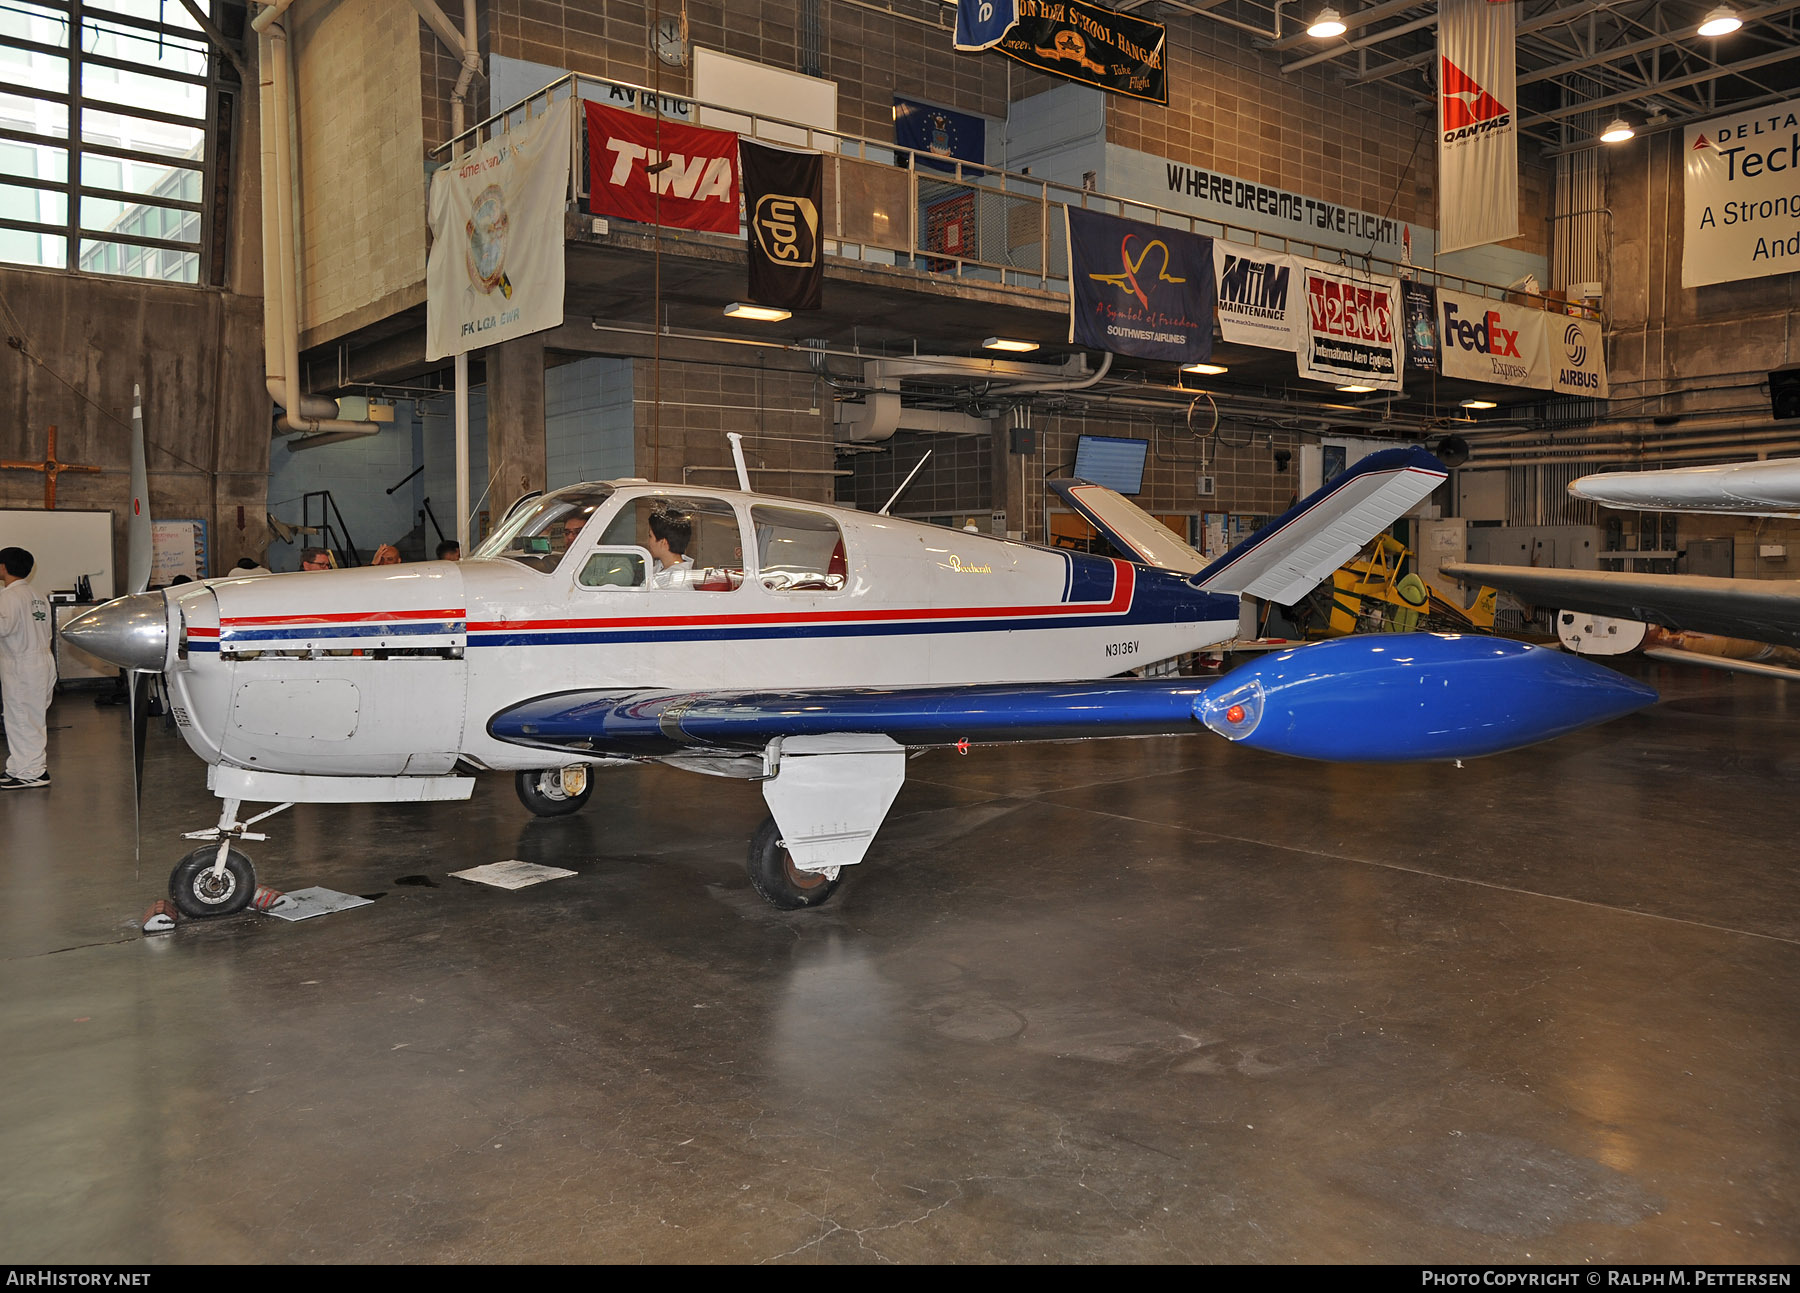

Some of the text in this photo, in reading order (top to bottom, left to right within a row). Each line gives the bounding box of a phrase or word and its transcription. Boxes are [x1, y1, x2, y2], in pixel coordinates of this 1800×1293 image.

[1117, 32, 1163, 70] HANGAR
[1111, 64, 1132, 75] Take
[1129, 76, 1150, 91] Flight
[1443, 114, 1510, 143] QANTAS
[1719, 113, 1798, 143] DELTA
[606, 136, 732, 203] TWA
[761, 201, 800, 260] ups
[1348, 211, 1398, 245] FLIGHT!
[1700, 206, 1715, 230] A
[1752, 231, 1800, 261] And
[477, 315, 497, 332] LGA
[500, 307, 520, 325] EWR
[1096, 301, 1198, 328] A Symbol of Freedom
[1218, 301, 1285, 321] MAINTENANCE
[1309, 293, 1390, 338] V2500
[1107, 325, 1186, 345] SOUTHWEST AIRLINES
[1223, 317, 1290, 332] www.mach2maintenance.com
[1443, 301, 1521, 359] FedEx
[1315, 343, 1392, 369] International Aero Engines
[1491, 358, 1528, 379] Express
[1559, 368, 1599, 389] AIRBUS
[949, 554, 992, 574] Beechcraft
[1105, 640, 1140, 658] N3136V
